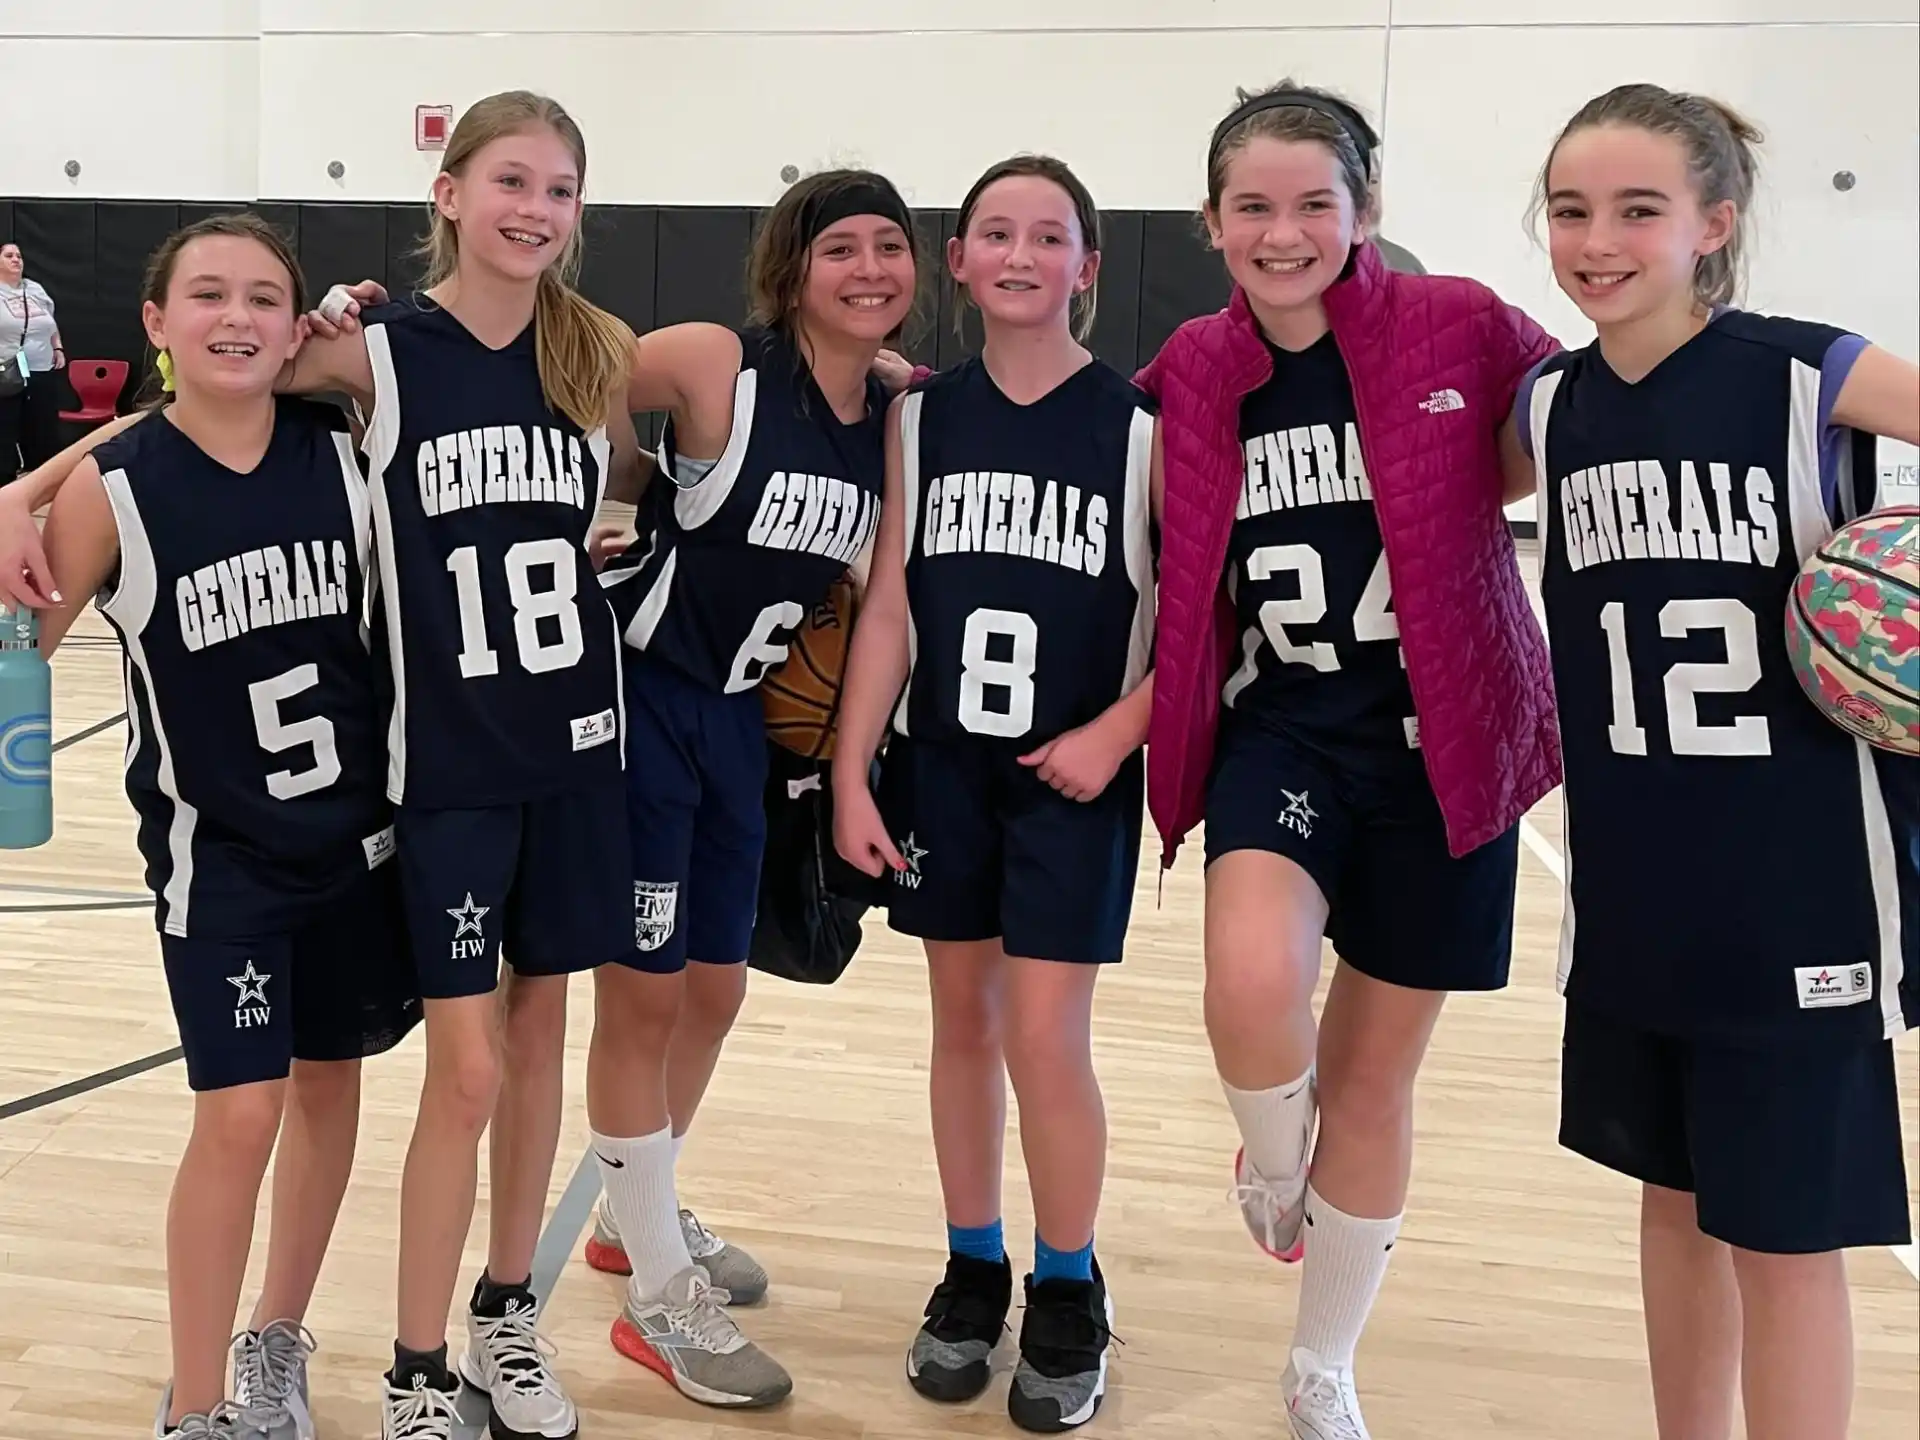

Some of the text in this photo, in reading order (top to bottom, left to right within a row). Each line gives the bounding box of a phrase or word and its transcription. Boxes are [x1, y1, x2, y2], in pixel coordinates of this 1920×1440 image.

[417, 425, 585, 517] GENERALS
[747, 471, 881, 565] GENERA
[1236, 422, 1373, 520] ENERA
[1560, 459, 1780, 572] GENERALS
[923, 471, 1109, 578] GENERALS
[176, 540, 348, 652] GENERALS
[446, 538, 584, 679] 18
[957, 607, 1038, 738] 8
[1600, 598, 1772, 756] 12
[248, 663, 342, 801] 5
[1277, 810, 1312, 840] HW
[635, 895, 673, 917] HW
[893, 869, 922, 890] HW
[451, 938, 485, 960] HW
[1855, 971, 1865, 987] S
[234, 1006, 271, 1029] HW
